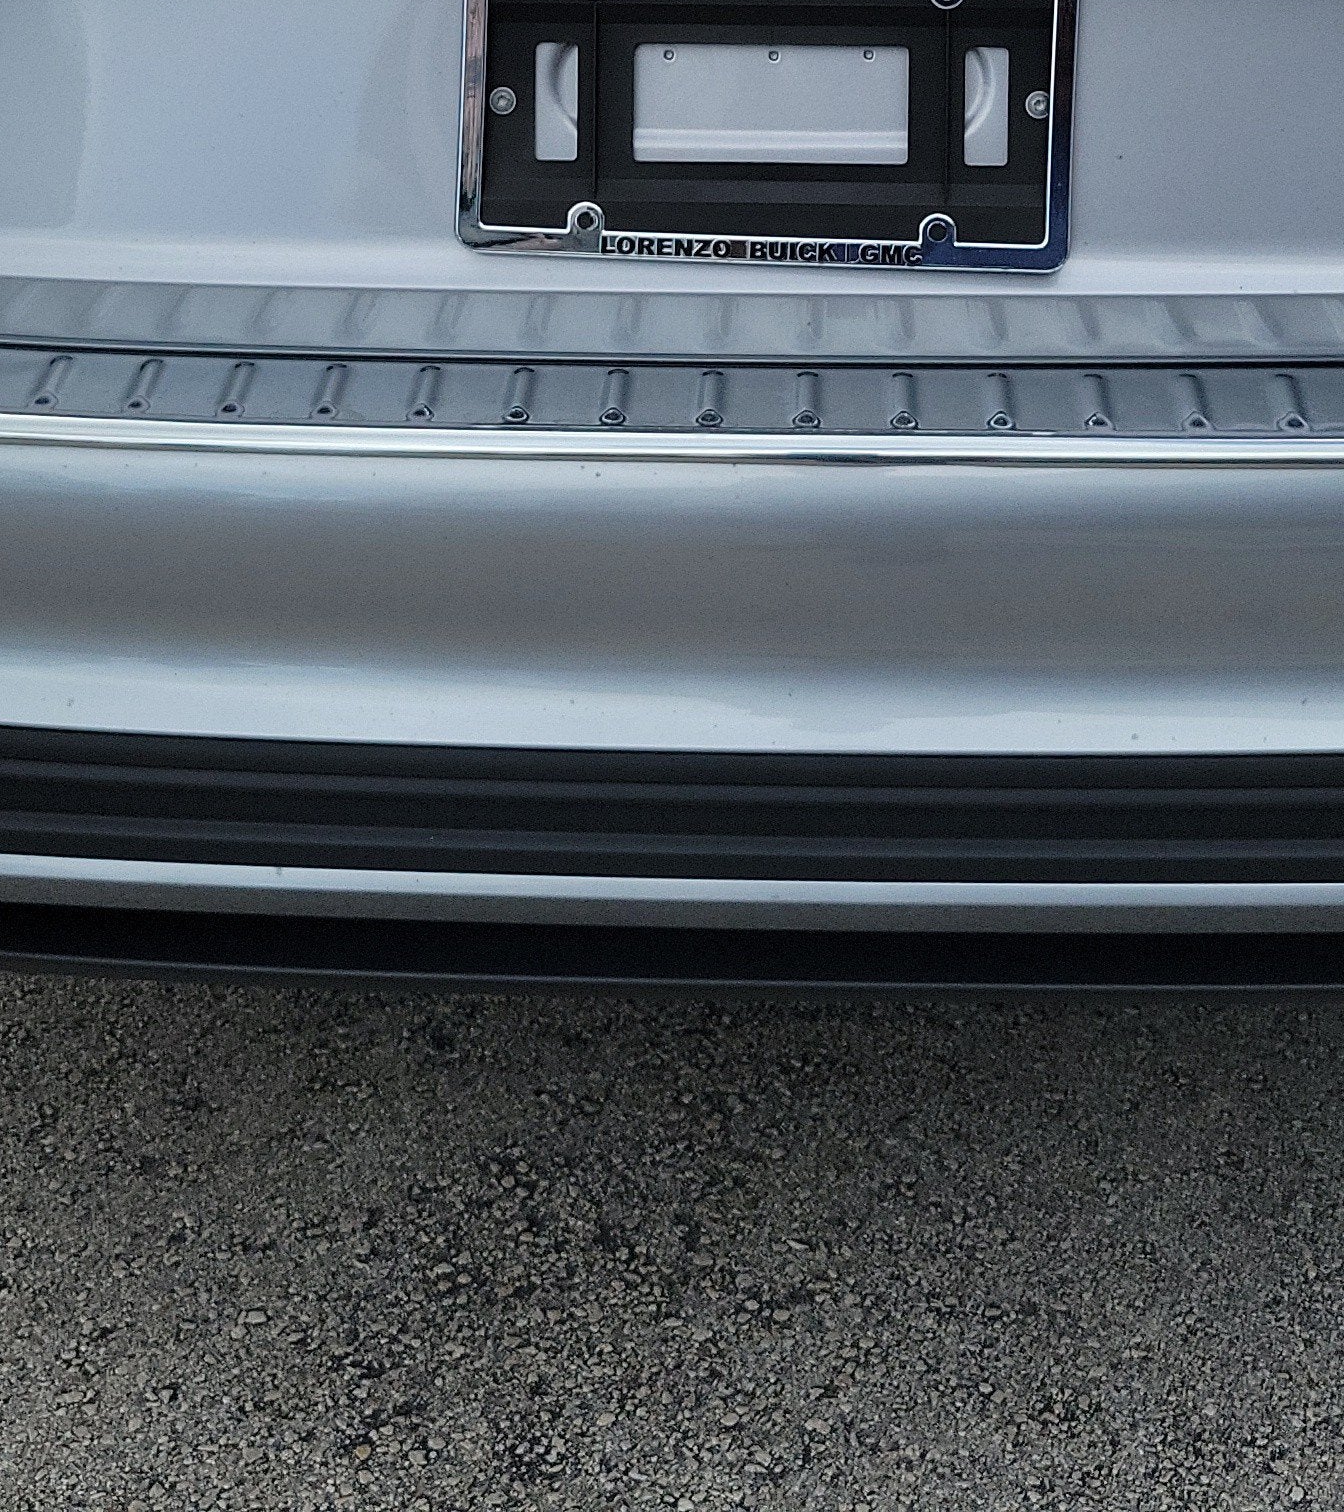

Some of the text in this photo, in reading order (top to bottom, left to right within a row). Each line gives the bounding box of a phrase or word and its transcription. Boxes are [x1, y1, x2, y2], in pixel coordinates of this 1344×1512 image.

[600, 235, 923, 266] LORENZO BUICK GMC
